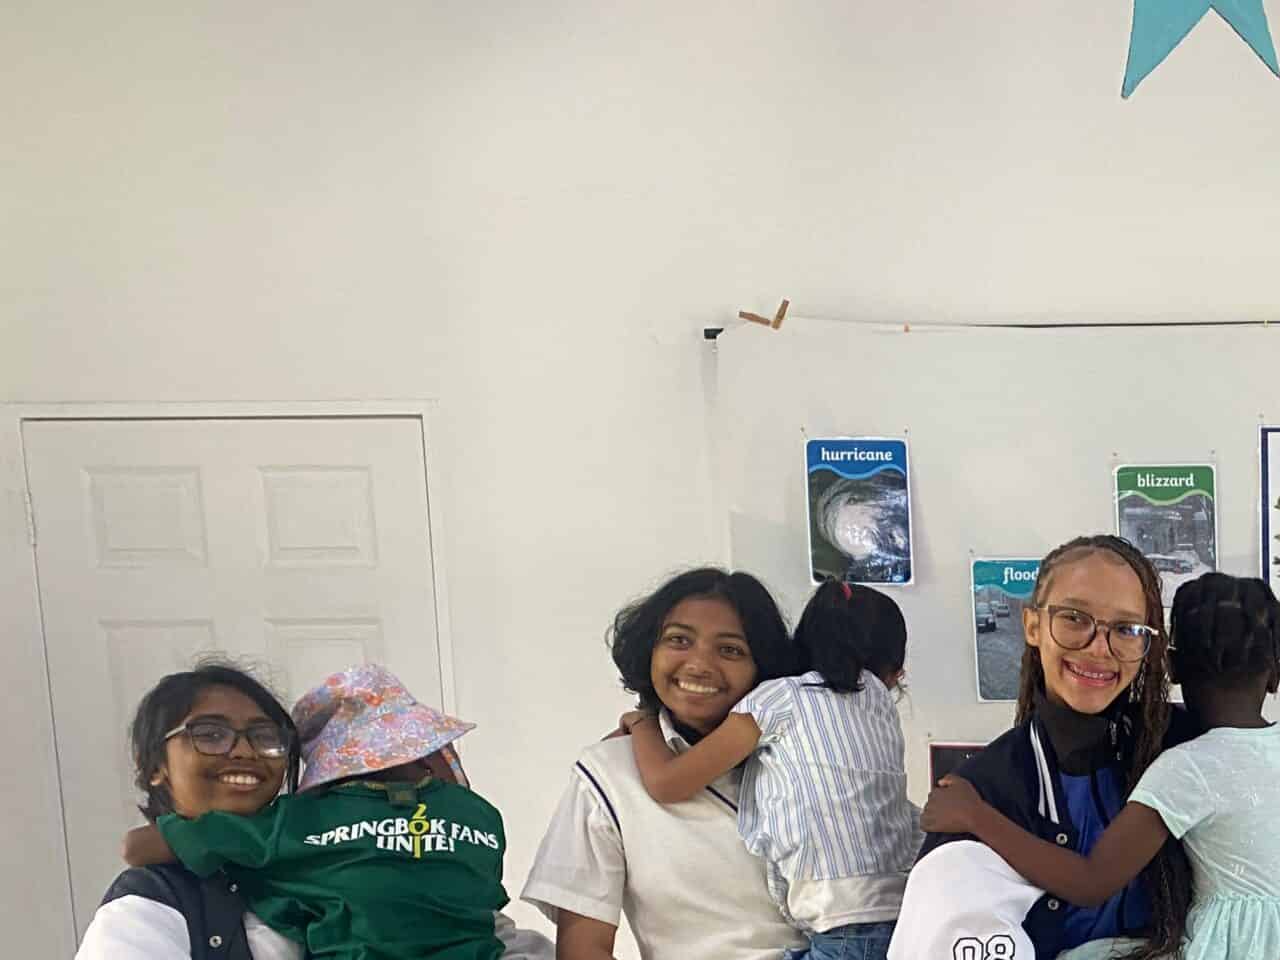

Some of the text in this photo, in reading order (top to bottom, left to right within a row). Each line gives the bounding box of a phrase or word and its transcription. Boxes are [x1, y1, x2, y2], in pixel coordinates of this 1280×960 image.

[821, 447, 893, 461] hurricane
[1137, 473, 1195, 488] blizzard
[303, 817, 499, 849] SPRINGBOK FANS
